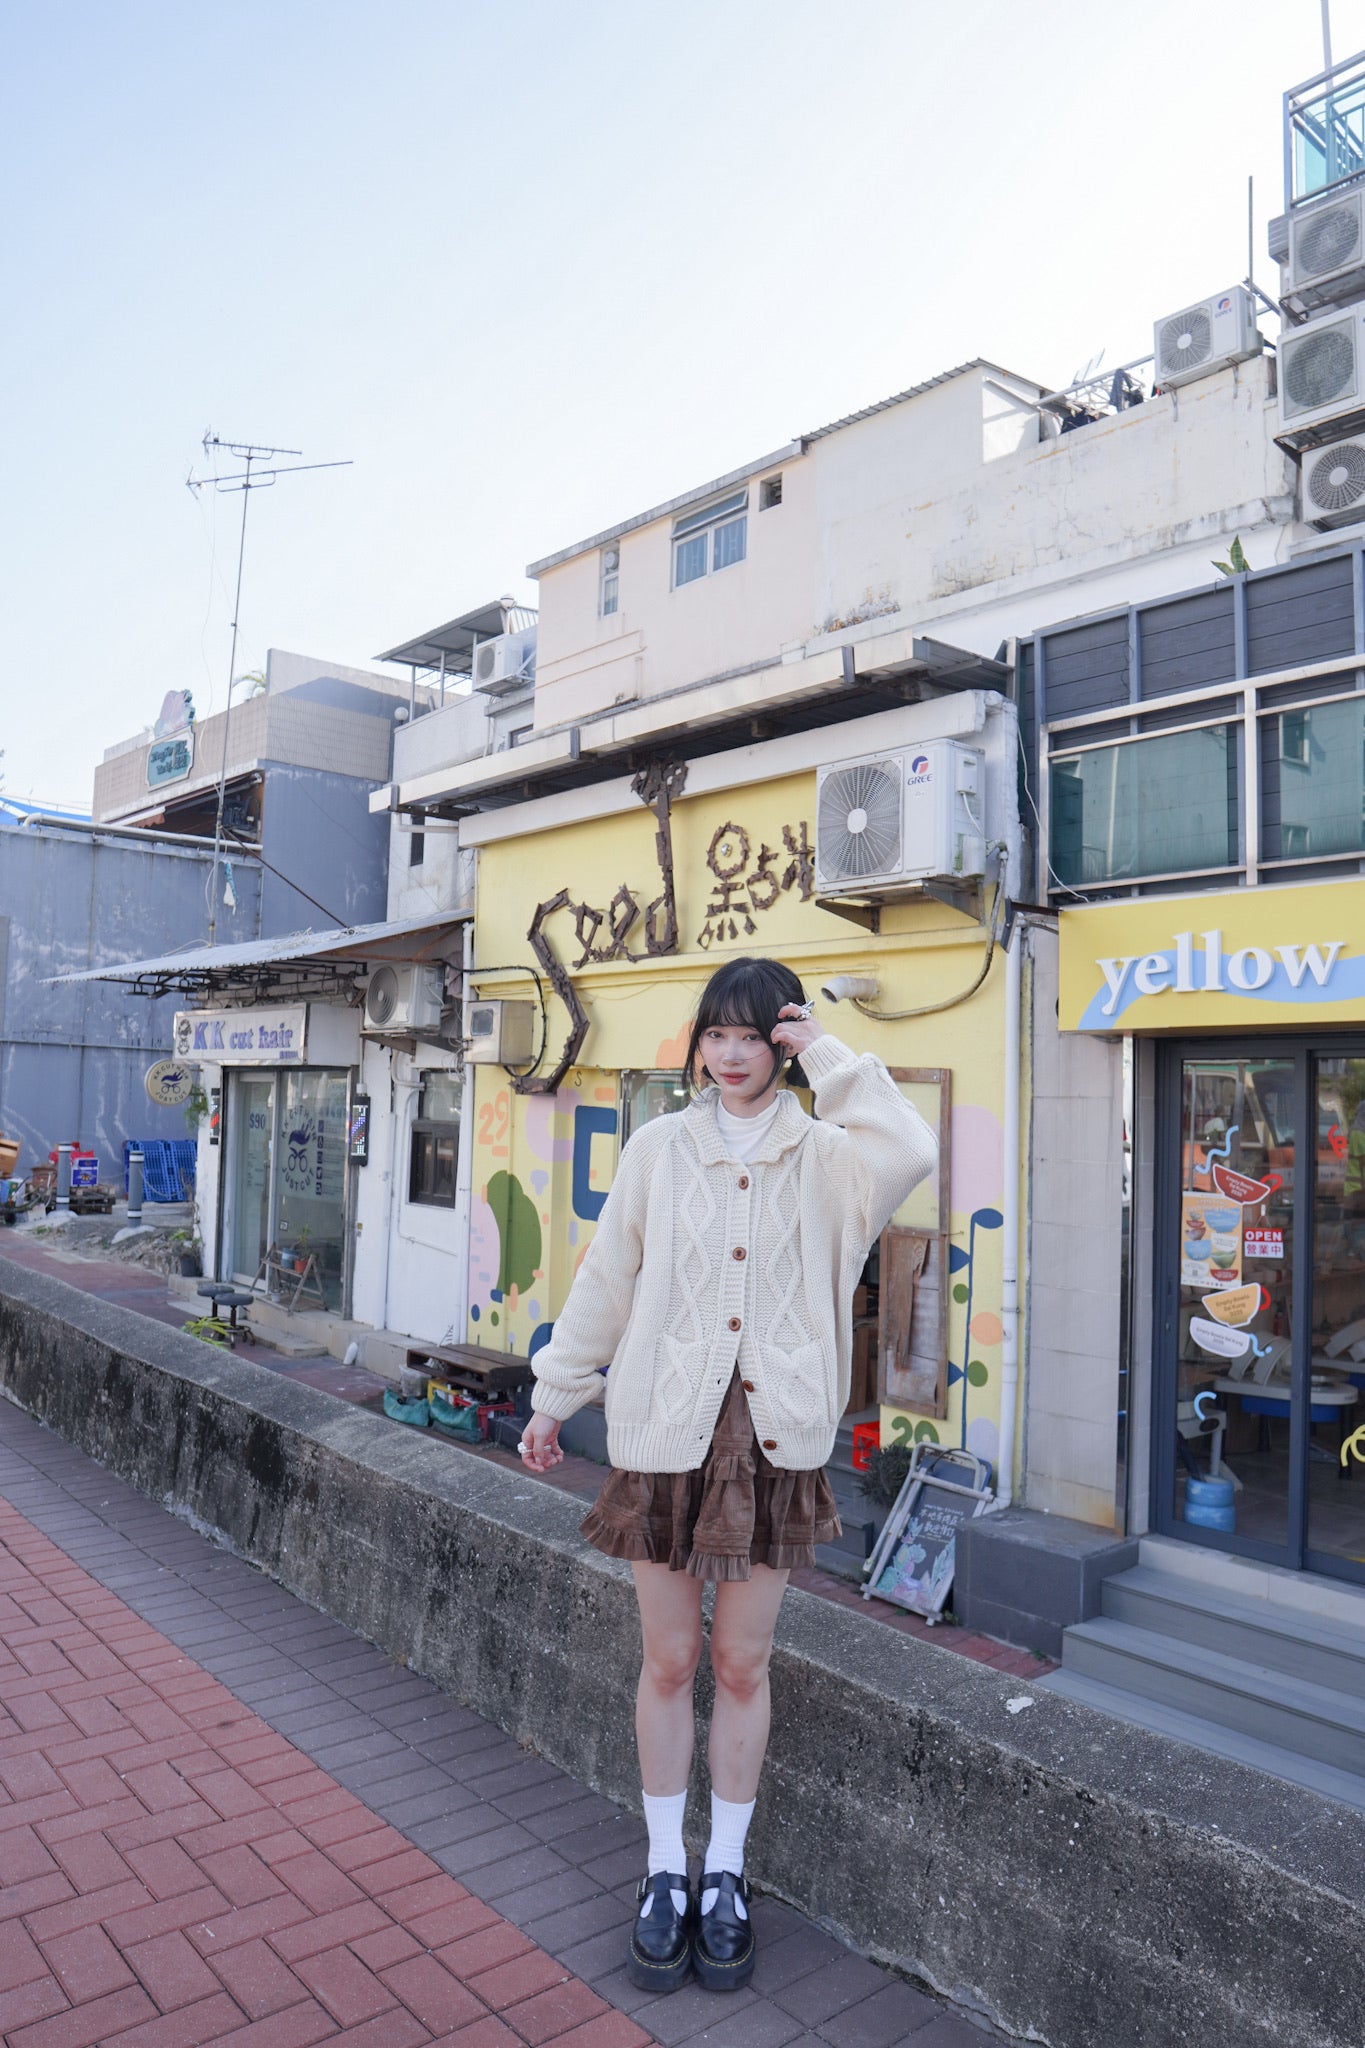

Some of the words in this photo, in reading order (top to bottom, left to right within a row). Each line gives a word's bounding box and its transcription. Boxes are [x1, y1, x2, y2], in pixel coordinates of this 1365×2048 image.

[907, 773, 933, 786] GREE
[1095, 928, 1347, 1016] yellow
[229, 1028, 254, 1050] cut
[258, 1022, 293, 1049] hair
[249, 1113, 266, 1129] $90
[478, 1091, 509, 1145] 29
[1245, 1231, 1282, 1242] OPEN
[1246, 1244, 1281, 1256] 營業中
